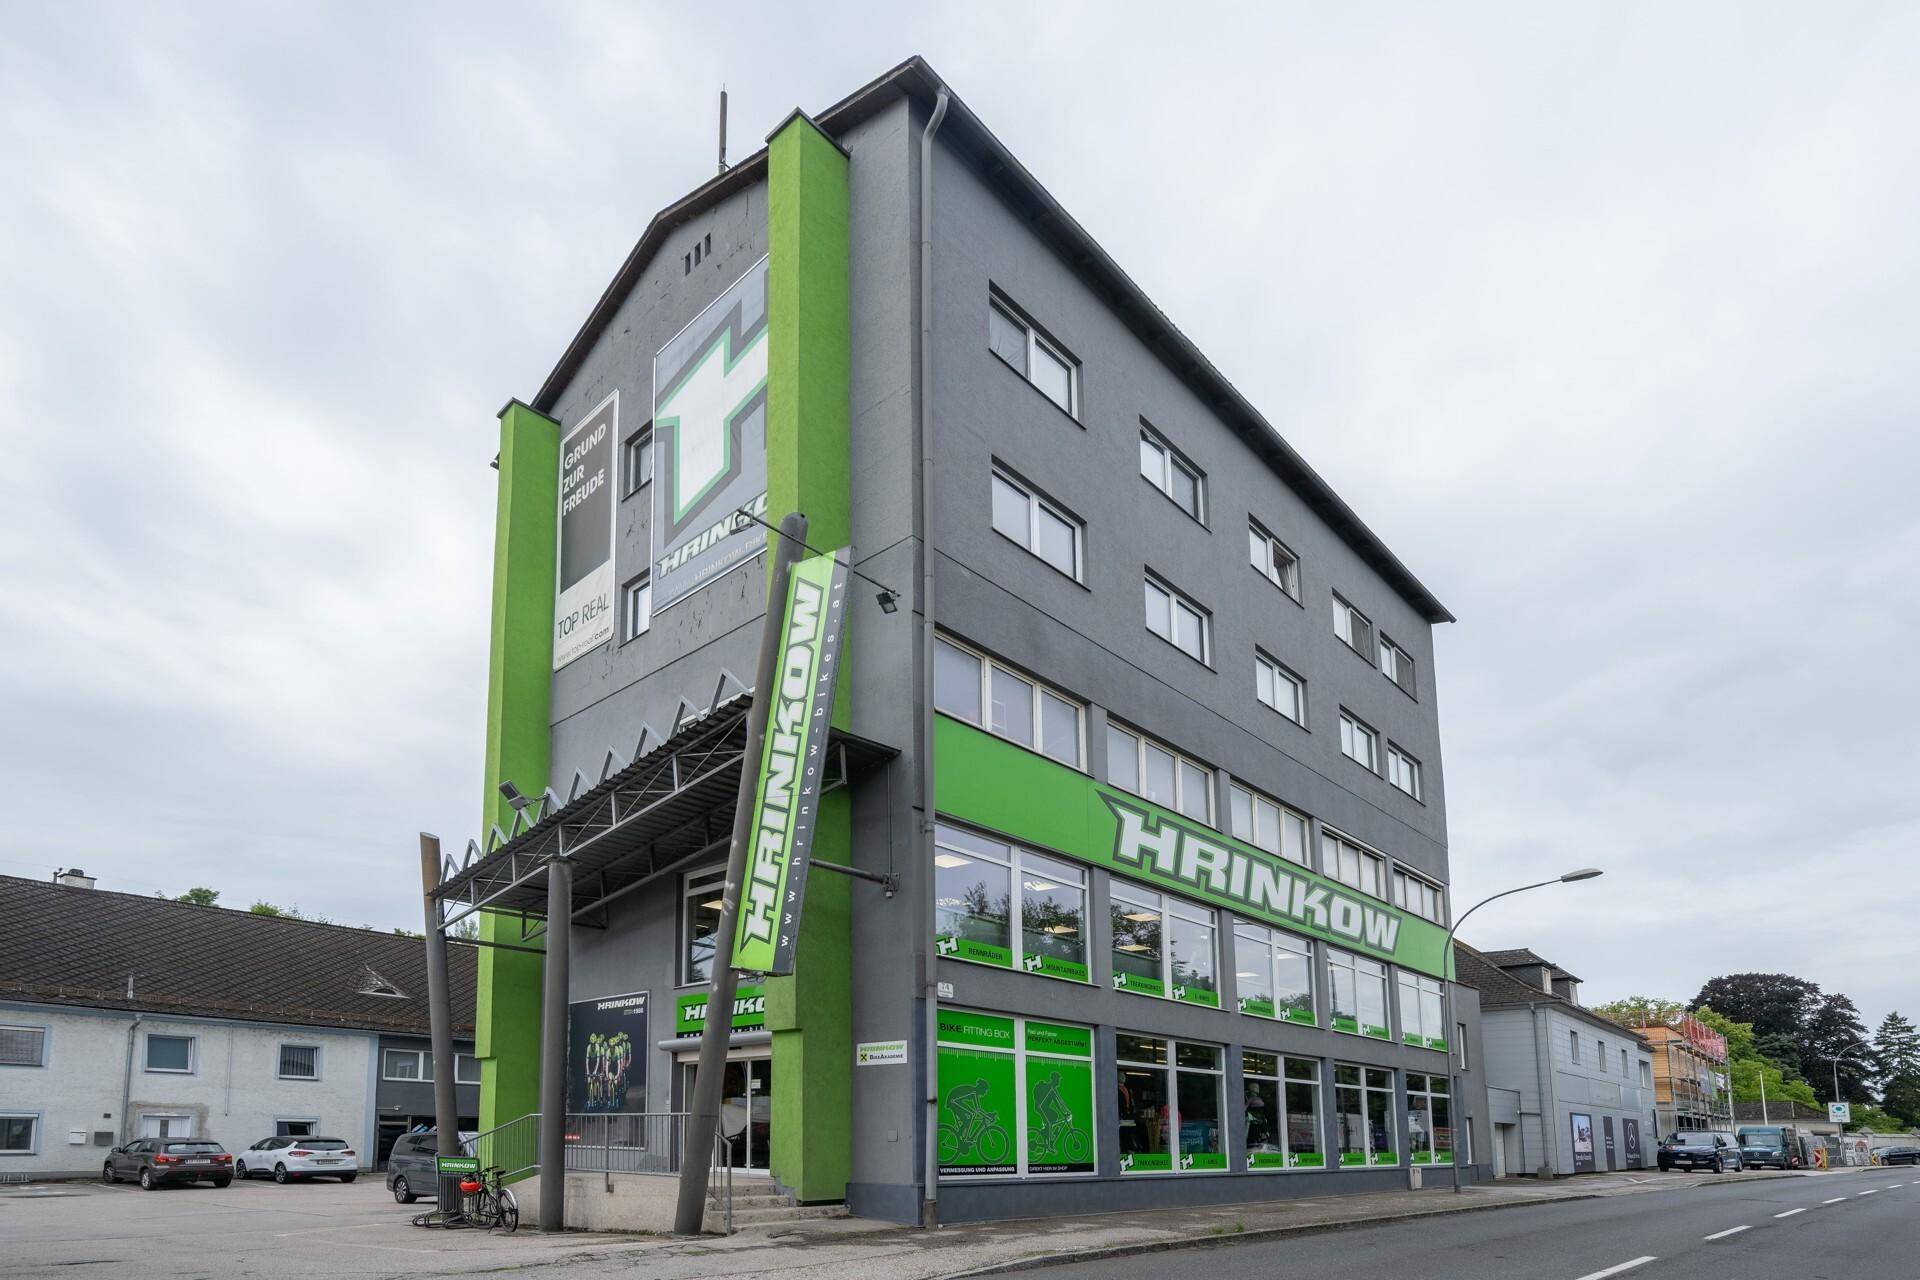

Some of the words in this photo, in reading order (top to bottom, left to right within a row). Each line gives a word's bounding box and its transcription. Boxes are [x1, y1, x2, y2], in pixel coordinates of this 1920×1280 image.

[564, 423, 607, 470] GRUND
[563, 464, 585, 494] ZUR
[563, 468, 605, 517] FREUDE
[655, 491, 768, 579] HRINKO
[557, 611, 579, 639] TOP
[582, 594, 609, 624] REAL
[740, 577, 824, 953] HRINKOW
[1096, 790, 1401, 955] HRINKOW
[597, 996, 646, 1010] HRINKOW
[940, 1022, 962, 1032] BIKE
[963, 1025, 993, 1037] FITTING
[993, 1029, 1010, 1039] BOX
